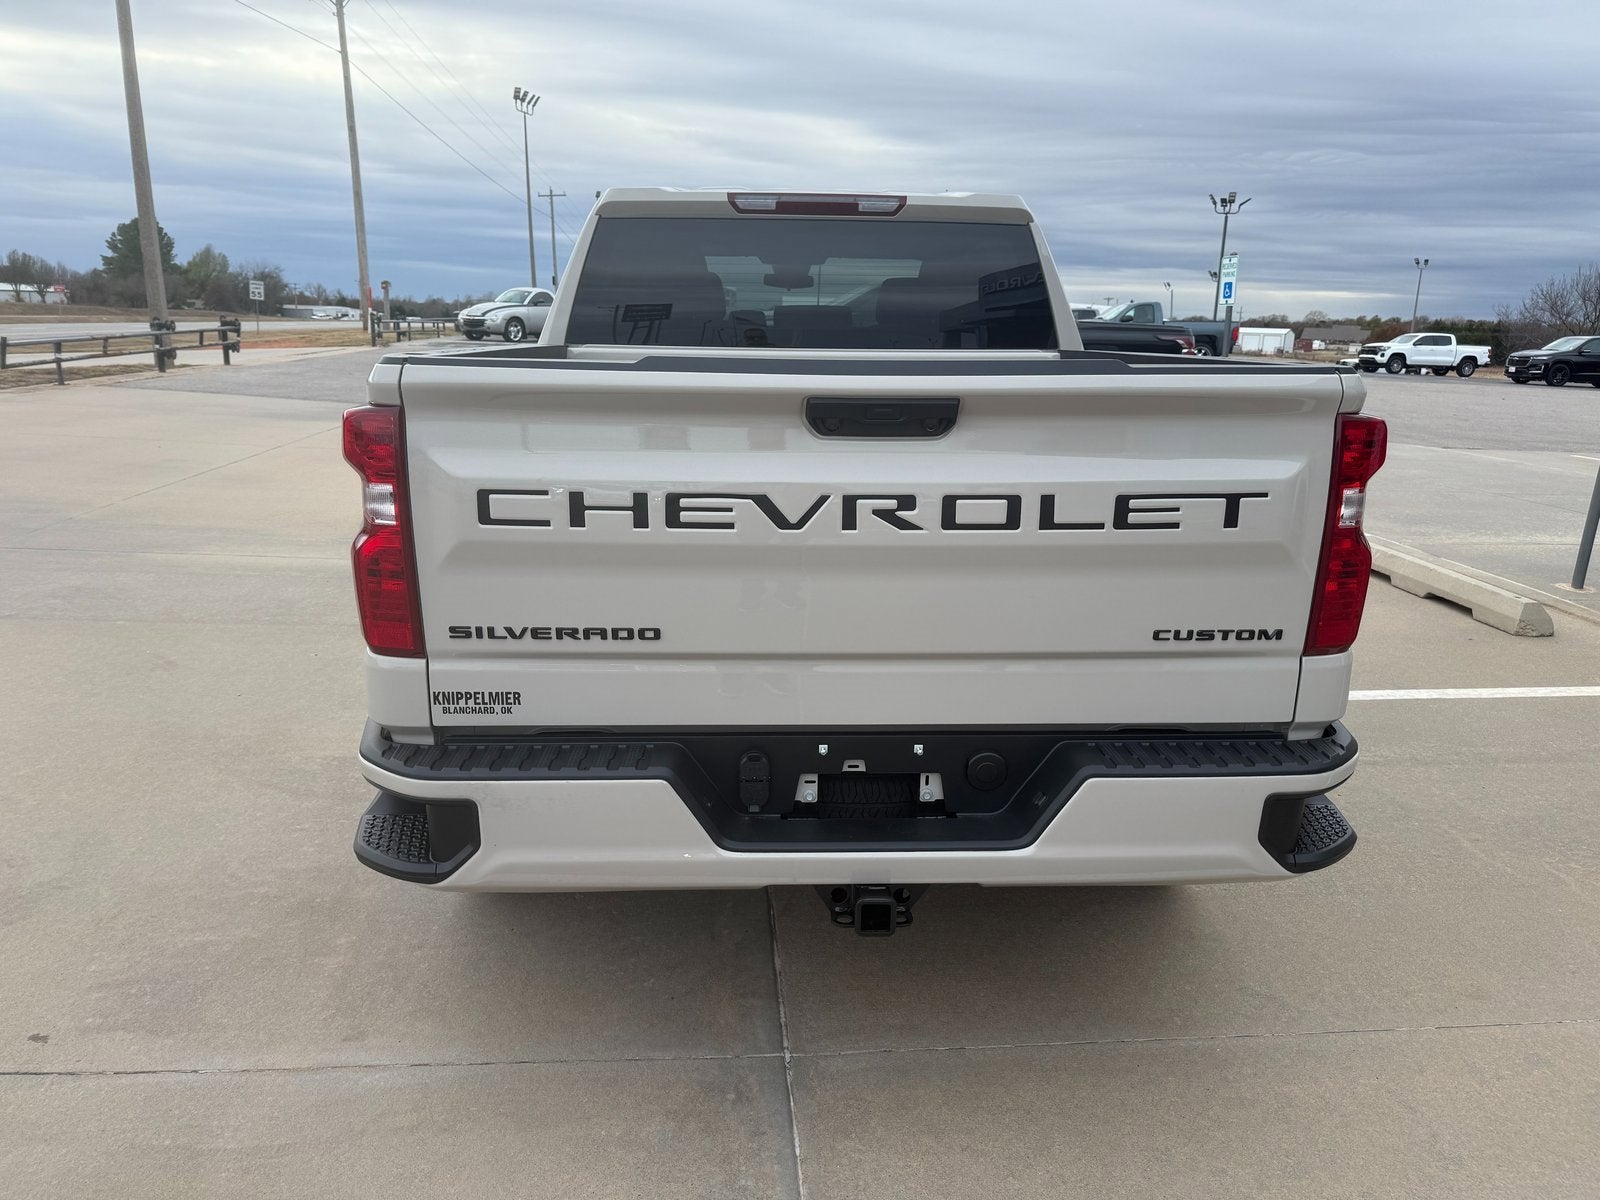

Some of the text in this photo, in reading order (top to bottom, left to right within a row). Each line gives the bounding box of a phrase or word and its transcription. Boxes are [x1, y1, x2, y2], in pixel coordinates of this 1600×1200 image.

[251, 290, 263, 298] 55
[476, 488, 1269, 531] CHEVROLET
[448, 625, 662, 641] SILVERADO
[1152, 628, 1284, 641] CUSTOM
[432, 691, 522, 706] KNIPPELMIER
[442, 706, 513, 715] BLANCHARD, OK
